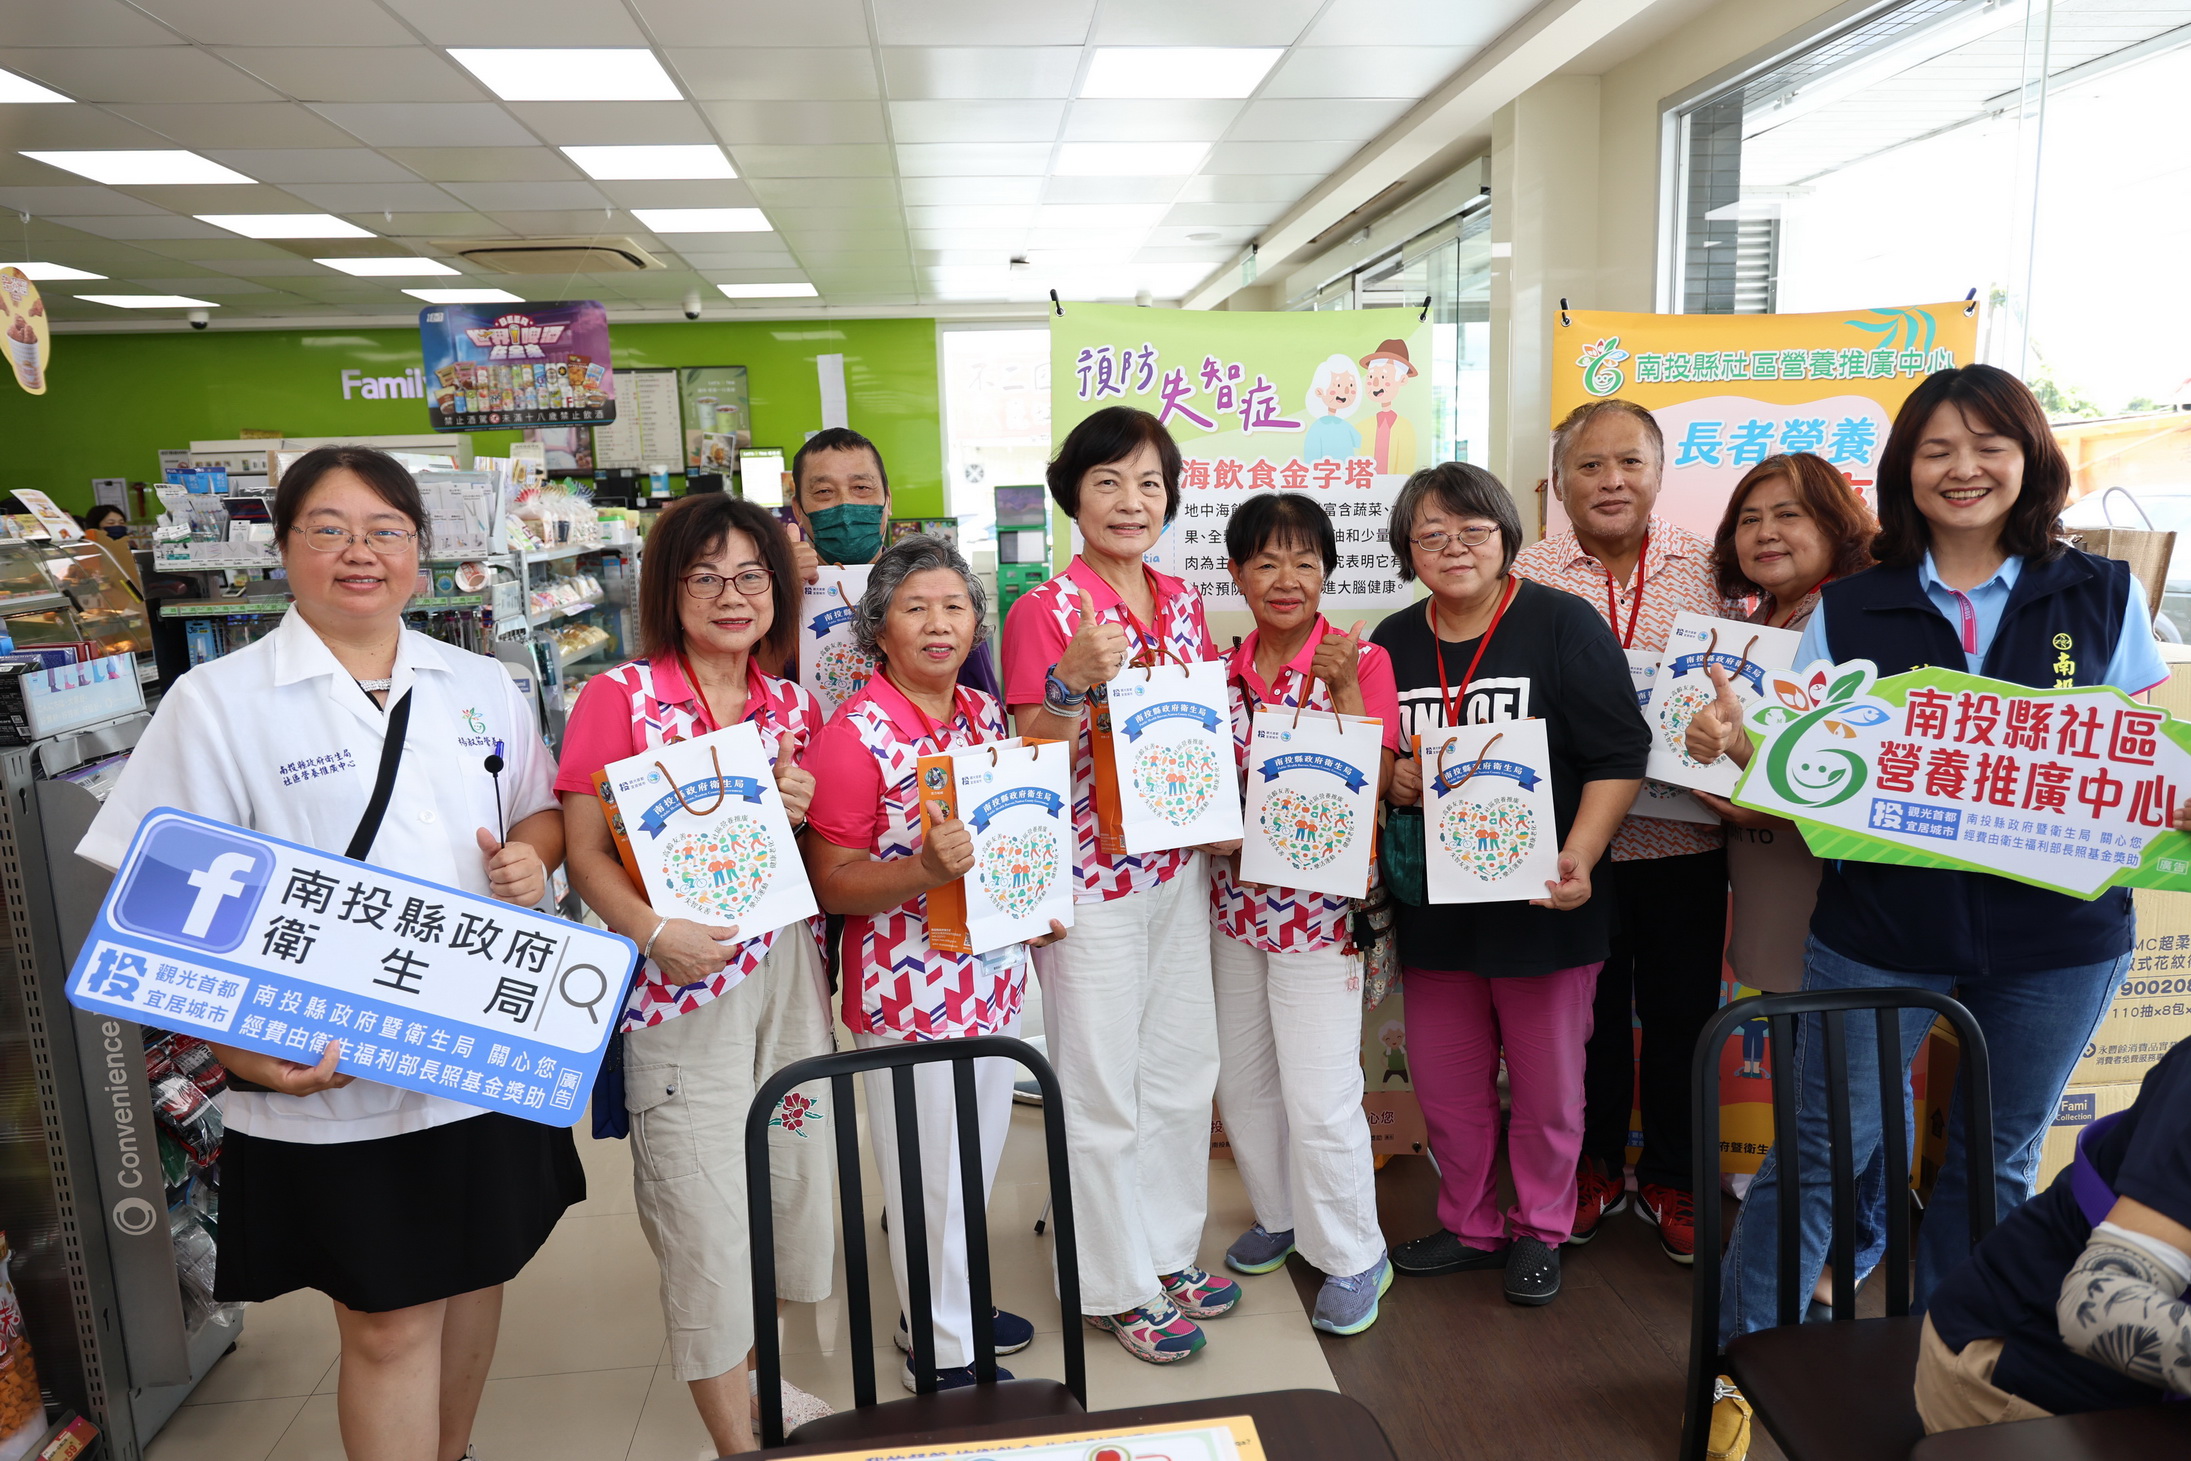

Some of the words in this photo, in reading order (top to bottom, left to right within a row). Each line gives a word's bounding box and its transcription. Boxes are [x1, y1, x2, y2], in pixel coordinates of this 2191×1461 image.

[499, 315, 529, 327] BEER
[1635, 350, 1954, 383] 南投縣社區營養推廣中心
[341, 367, 426, 400] Famil
[1077, 344, 1301, 431] 預防失智症
[444, 413, 489, 426] 禁止酒駕
[501, 409, 605, 423] 未滿十八歲禁止飲酒
[1675, 417, 1877, 466] 長者營養
[1134, 703, 1207, 724] 南投縣政府衛生局
[1904, 688, 2162, 766] 南投縣社區
[280, 749, 352, 775] 南投縣政府衛生局
[283, 760, 356, 787] 社區營養推廣中心
[1274, 755, 1353, 776] 南投縣政府衛生局
[983, 789, 1052, 813] 南投縣政府衛生局
[1876, 740, 2176, 829] 營養推廣中心
[1872, 801, 1903, 830] 投
[1905, 821, 1954, 838] 宜居城市
[1908, 805, 1957, 823] 觀光首都
[1966, 812, 2091, 842] 南投縣政府暨衛生局
[2099, 832, 2143, 849] 關心您
[1746, 827, 1774, 844] TO
[1963, 829, 2139, 867] 經費由衛生福利部長照基金獎助
[2159, 859, 2187, 873] 廣告
[182, 852, 256, 939] f
[280, 867, 558, 973] 南投縣政府
[87, 947, 147, 1002] 投
[154, 963, 242, 1000] 觀光首都
[143, 988, 230, 1024] 宜居城市
[252, 983, 475, 1058] 南投縣政府暨衛生局
[487, 1043, 558, 1080] 關心您
[238, 1014, 546, 1109] 經費由衛生福利部長照基金獎助
[101, 1020, 143, 1189] Convenience
[555, 1072, 579, 1106] 廣告
[2061, 1099, 2087, 1112] Fami
[2056, 1112, 2092, 1121] Collection
